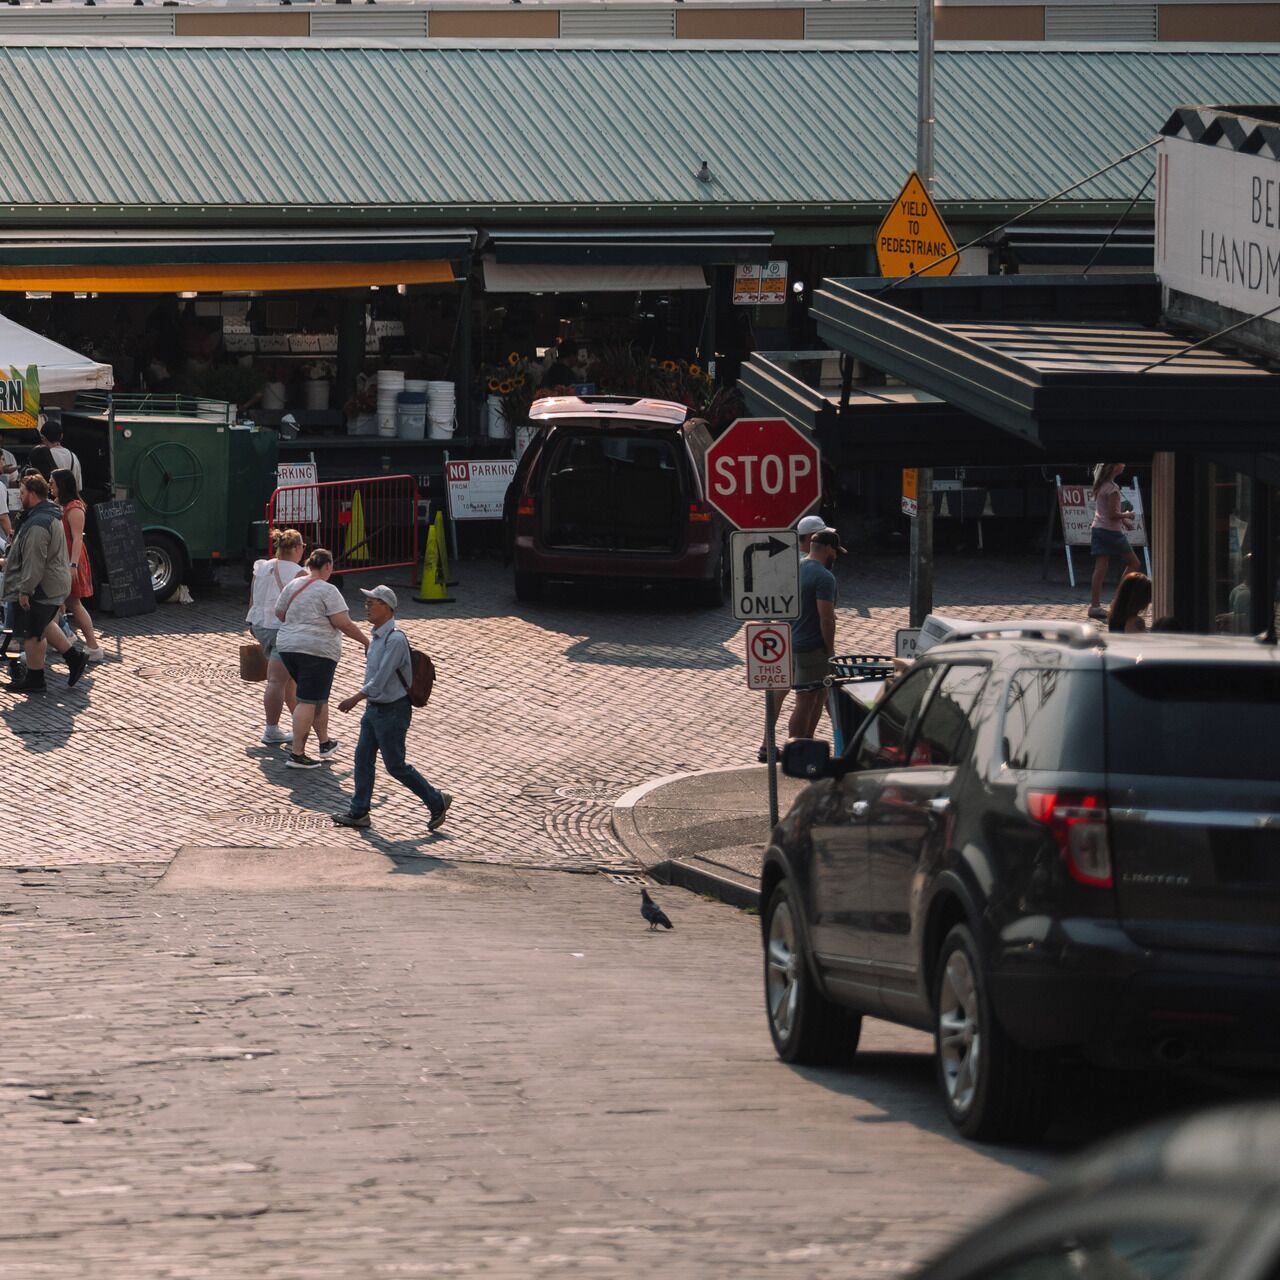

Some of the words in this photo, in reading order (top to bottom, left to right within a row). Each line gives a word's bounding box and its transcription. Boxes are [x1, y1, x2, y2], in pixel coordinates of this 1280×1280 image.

[901, 201, 928, 217] YIELD
[1251, 176, 1280, 230] BE
[908, 220, 920, 236] TO
[881, 237, 947, 257] PEDESTRIANS
[279, 467, 313, 479] RKING
[450, 465, 466, 479] NO
[471, 464, 515, 476] PARKING
[714, 454, 811, 496] STOP
[1063, 489, 1081, 504] NO
[740, 595, 794, 615] ONLY
[757, 665, 782, 674] THIS
[753, 675, 787, 684] SPACE
